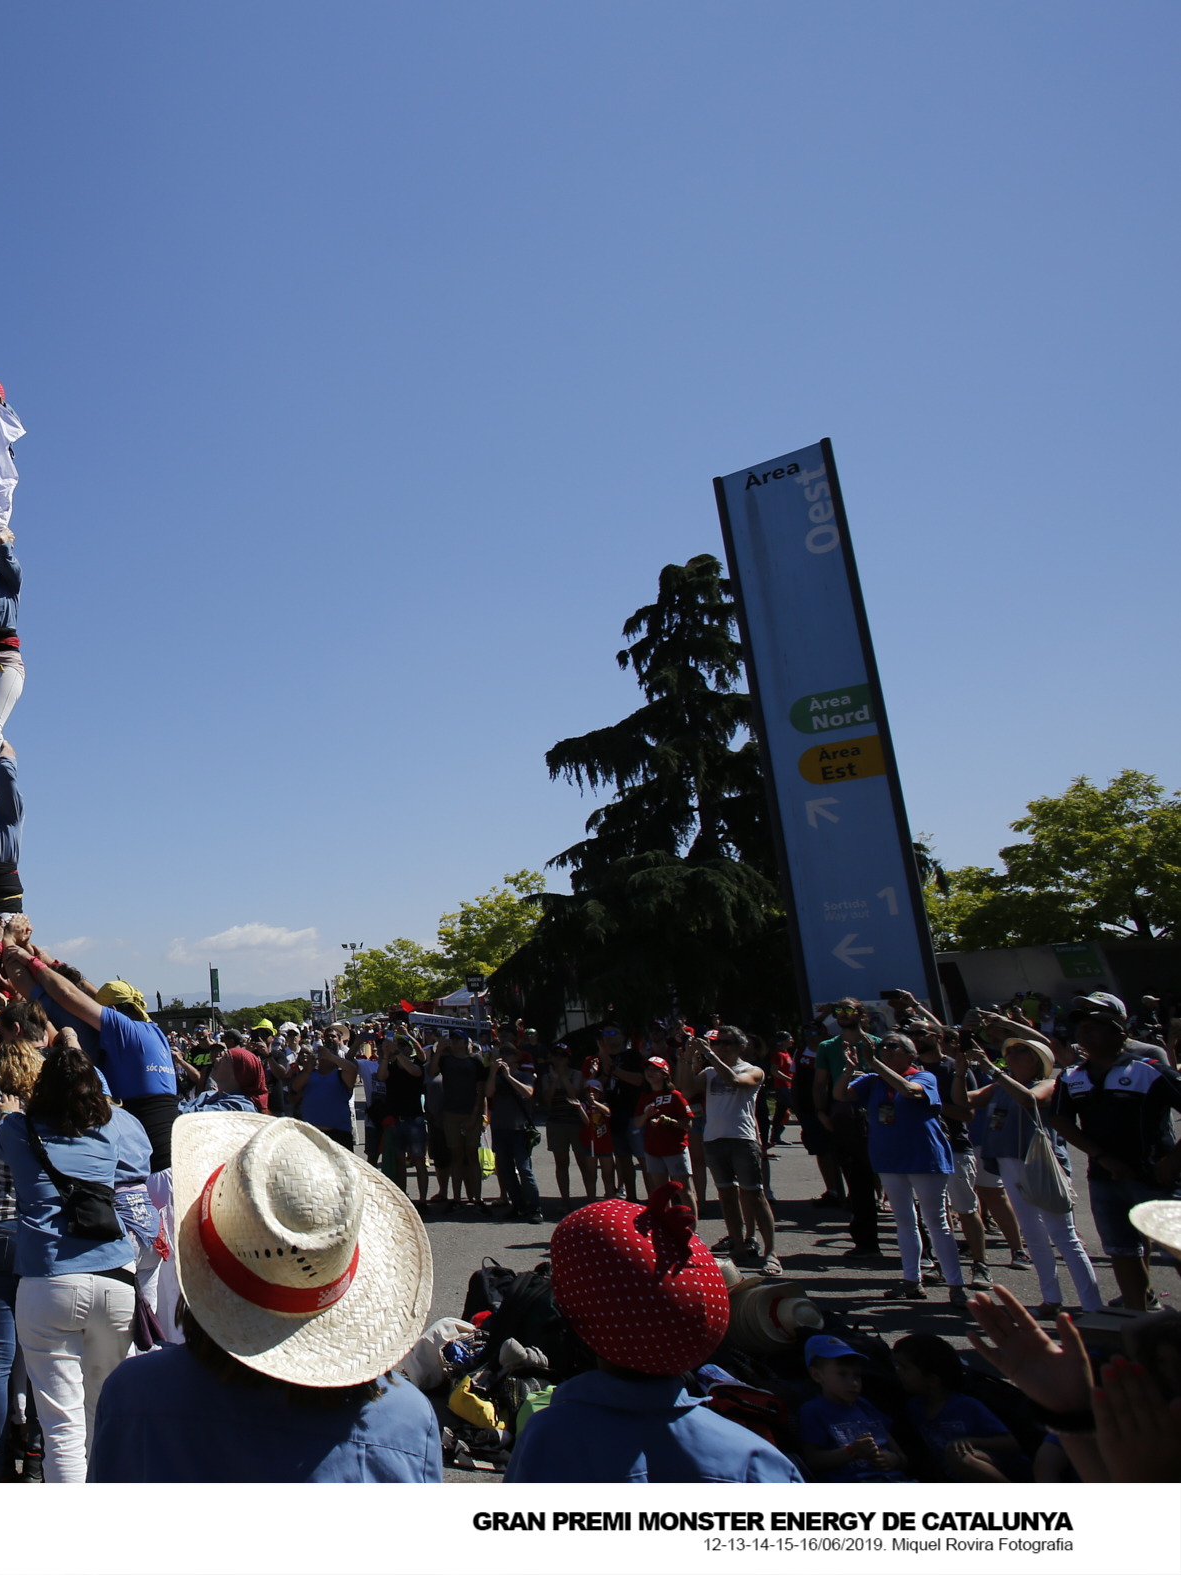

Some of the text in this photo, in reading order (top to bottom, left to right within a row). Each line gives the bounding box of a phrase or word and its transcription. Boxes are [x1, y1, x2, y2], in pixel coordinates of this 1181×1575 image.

[745, 462, 800, 490] Àrea
[794, 463, 840, 555] Oest
[809, 695, 851, 712] Àrea
[812, 705, 870, 731] Nord
[819, 746, 861, 762] Àrea
[821, 762, 858, 781] Est
[823, 899, 867, 911] Sortida
[876, 886, 899, 916] 1
[824, 909, 870, 923] Way out
[451, 1020, 488, 1028] PROGRAME
[655, 1094, 672, 1107] 93
[596, 1125, 608, 1139] 93
